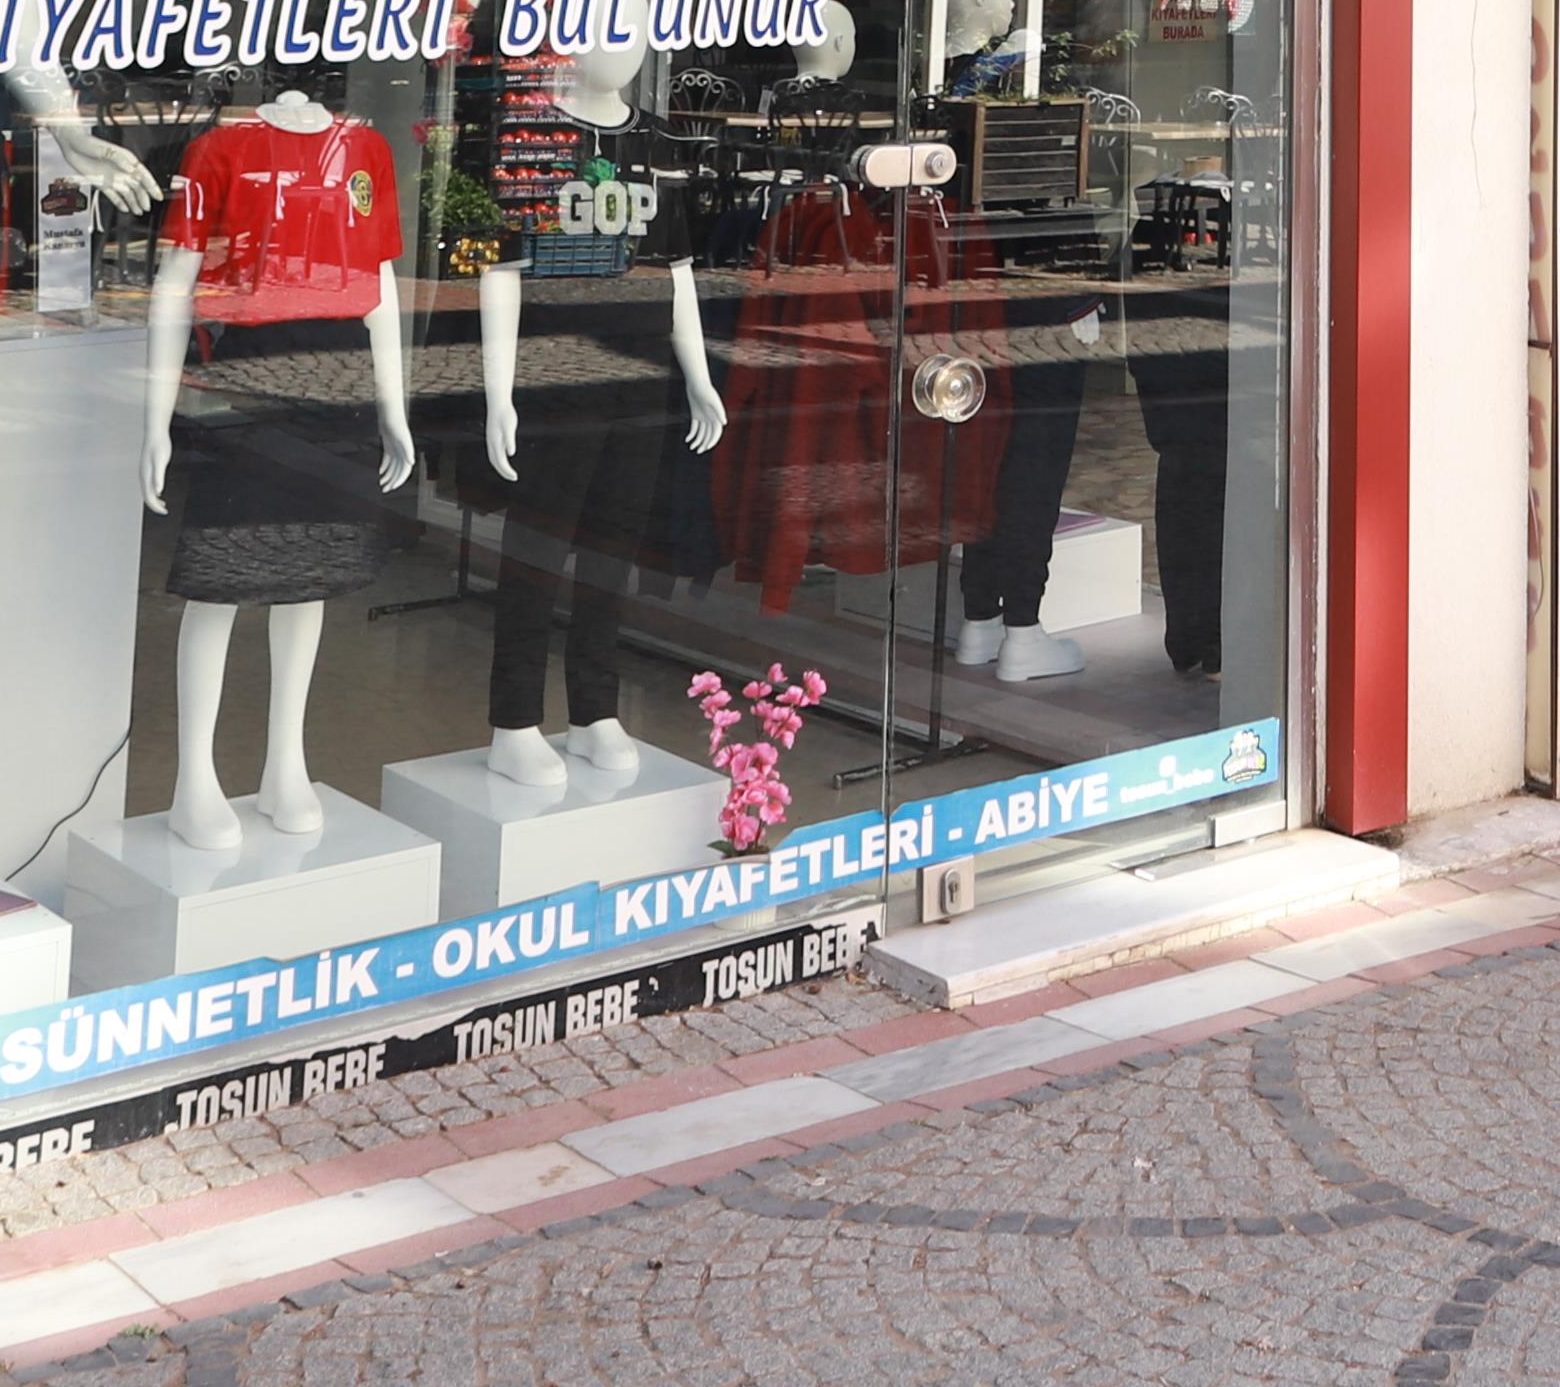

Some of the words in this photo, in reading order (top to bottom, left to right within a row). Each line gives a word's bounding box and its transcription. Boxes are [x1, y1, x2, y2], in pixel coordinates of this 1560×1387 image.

[558, 180, 658, 236] GOP
[431, 899, 590, 980] OKUL
[612, 804, 935, 937] KIYAFETLERİ
[975, 767, 1109, 855] ABİYE
[701, 938, 795, 1008] TOSUN
[453, 1000, 556, 1065] TOSUN
[565, 979, 640, 1039] BEBE
